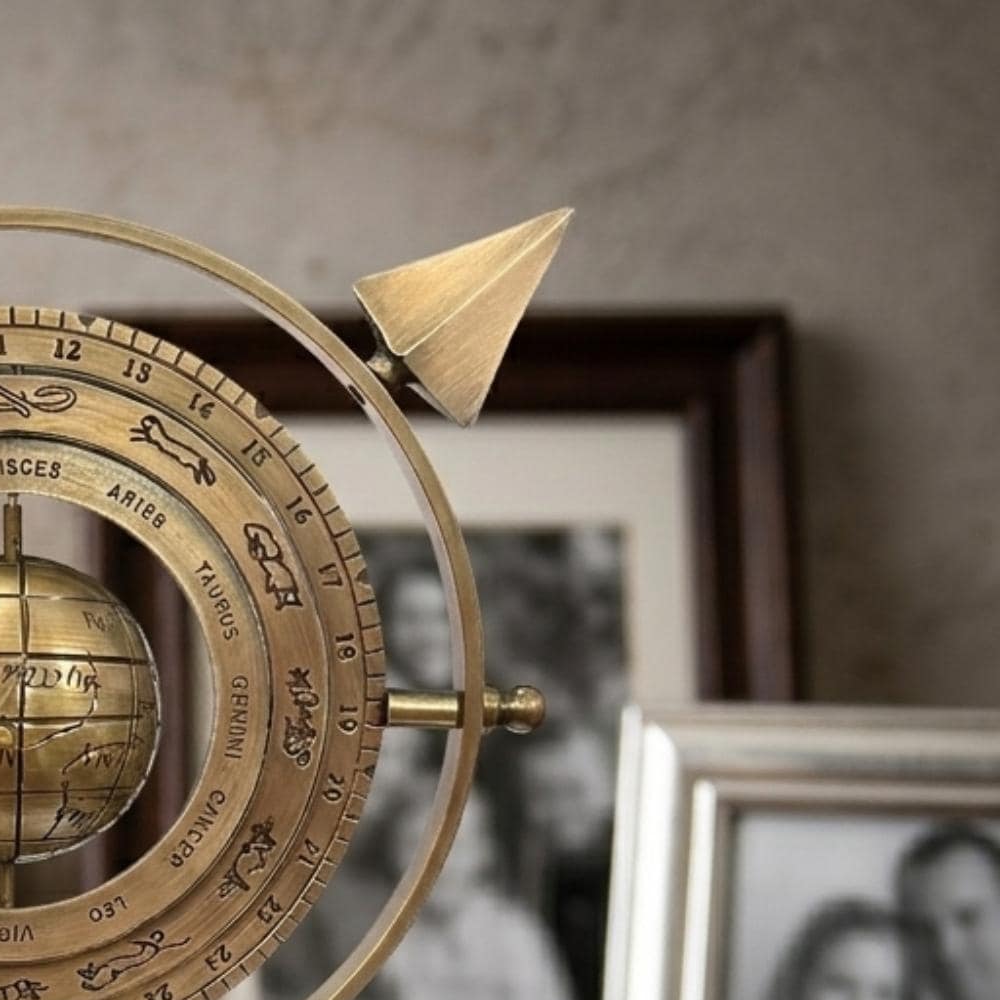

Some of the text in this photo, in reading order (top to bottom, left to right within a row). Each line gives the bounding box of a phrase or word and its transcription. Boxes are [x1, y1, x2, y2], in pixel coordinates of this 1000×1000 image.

[53, 338, 82, 361] 12
[286, 495, 313, 526] 16
[89, 897, 128, 923] LEO
